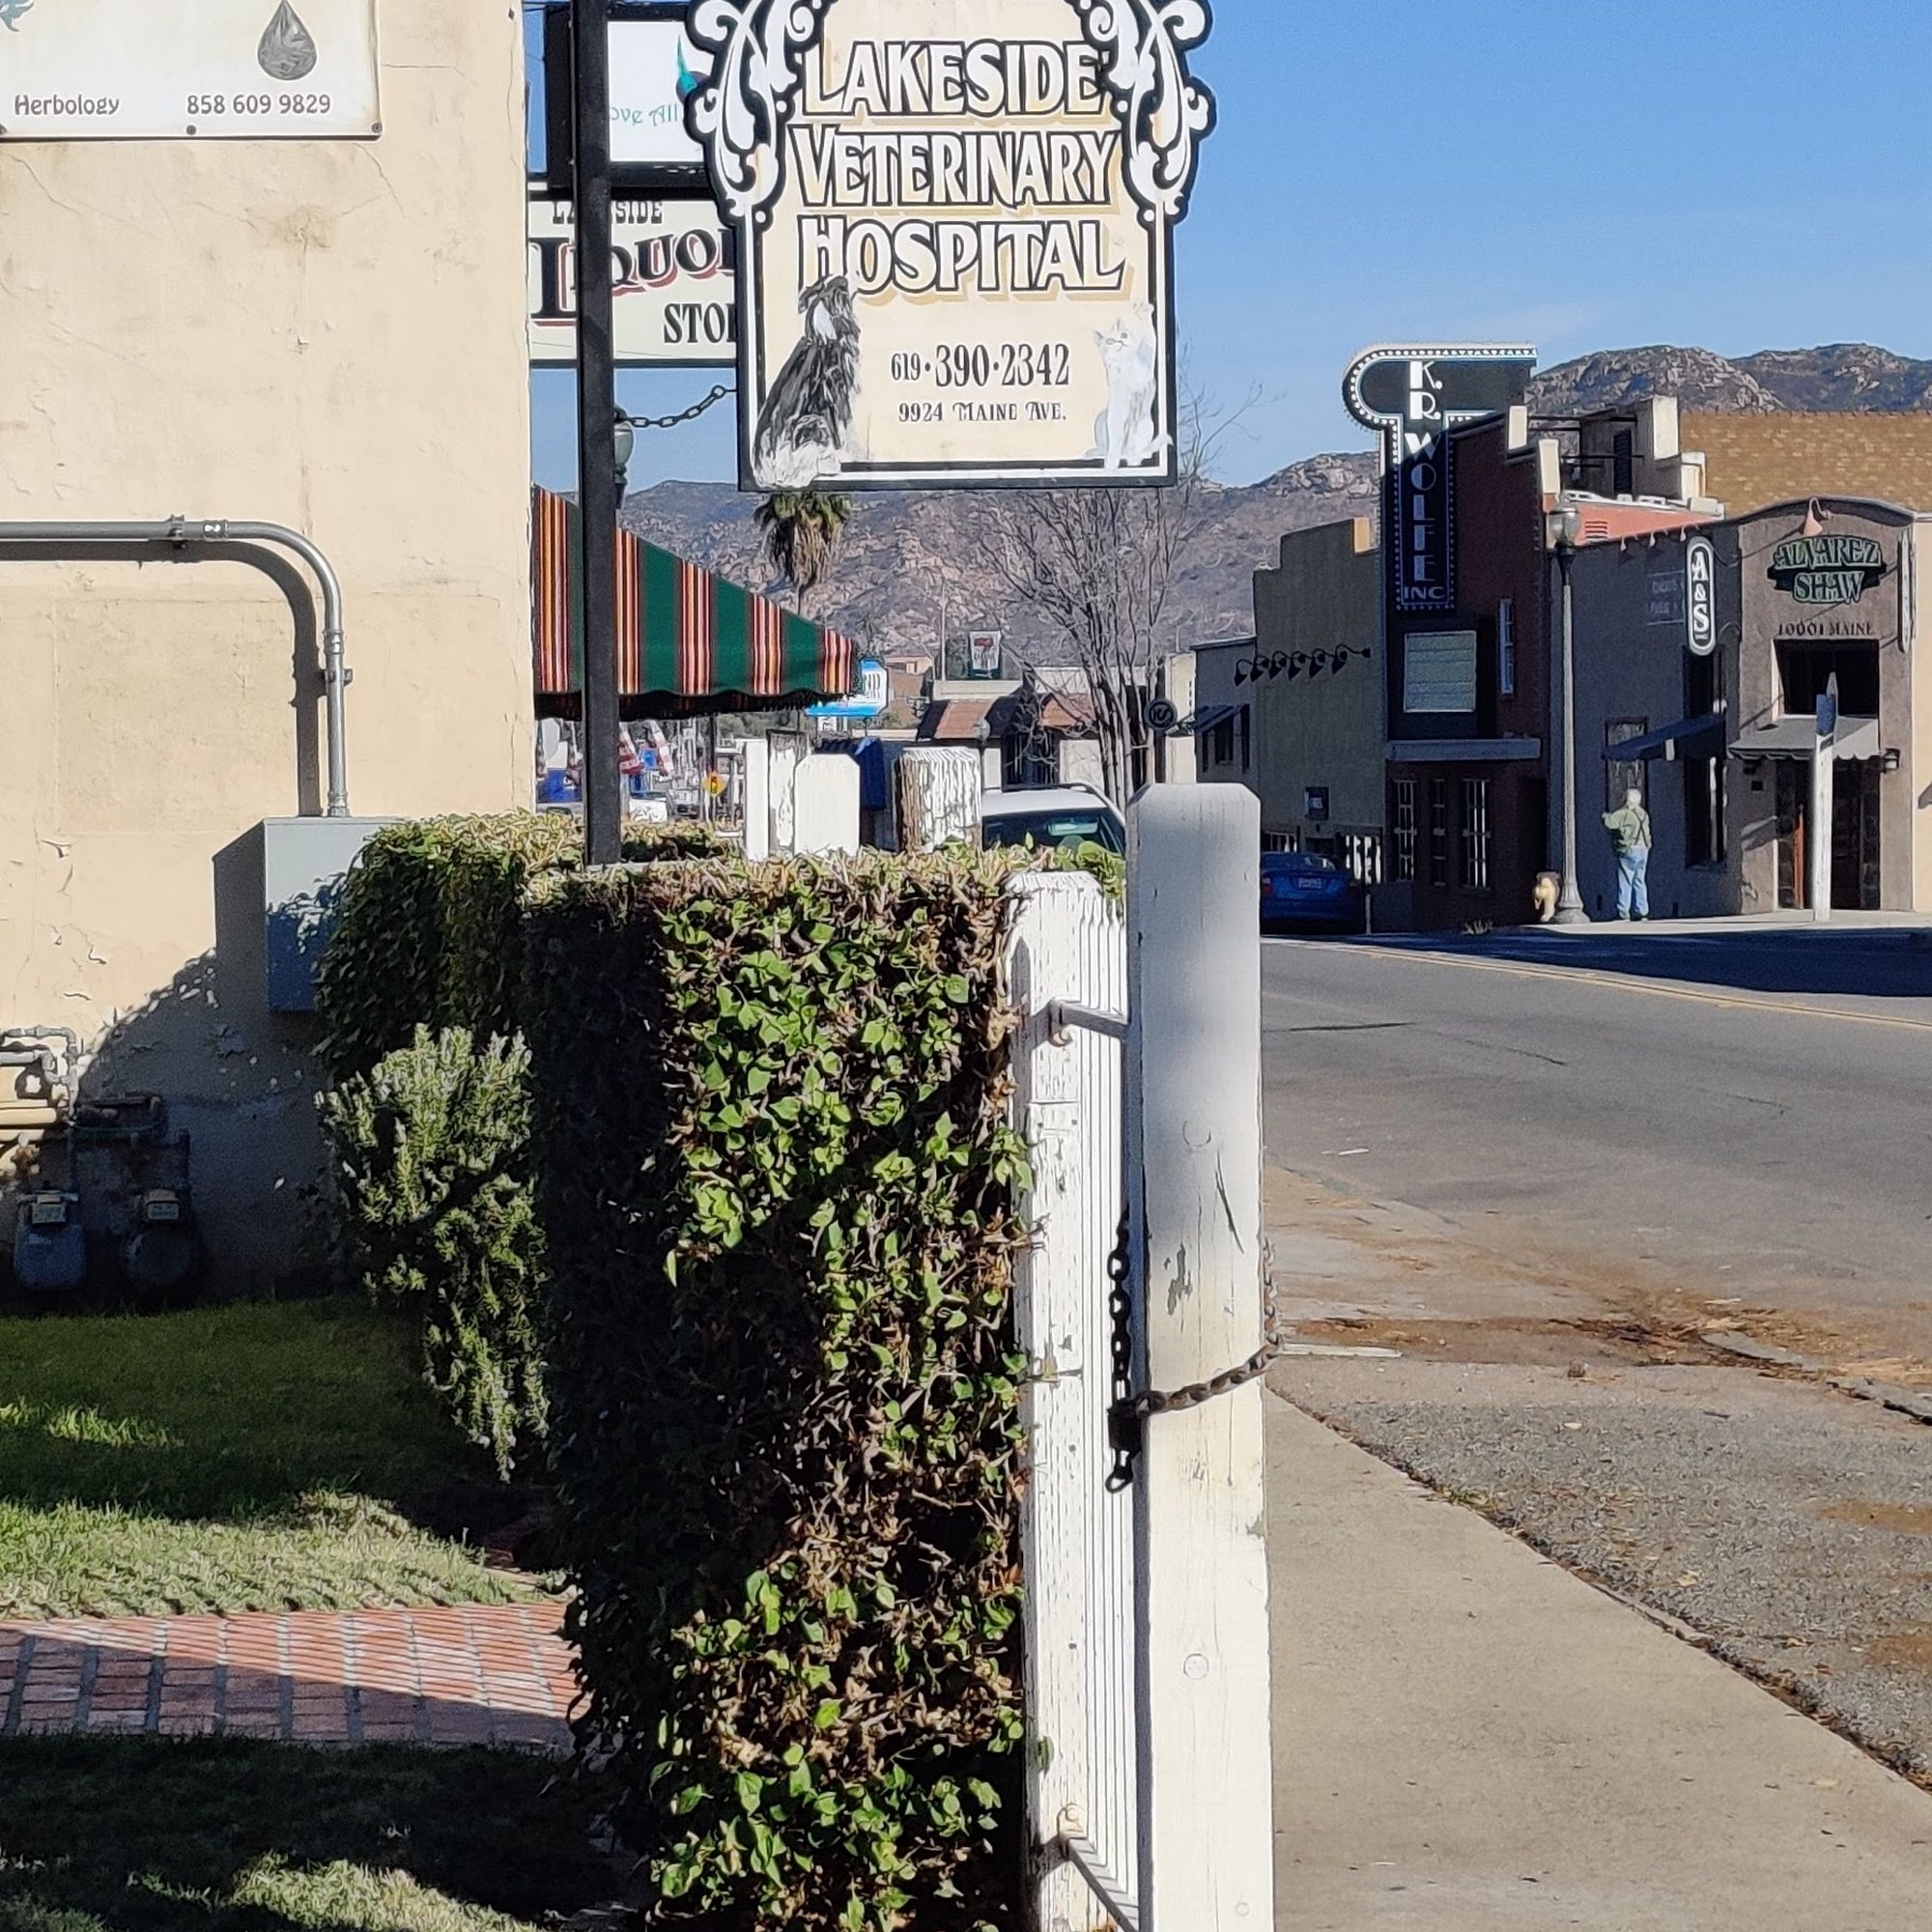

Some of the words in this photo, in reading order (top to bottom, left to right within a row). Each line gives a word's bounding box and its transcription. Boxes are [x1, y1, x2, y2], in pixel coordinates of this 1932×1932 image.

[803, 39, 1104, 117] LAKESIDE
[14, 94, 121, 116] Herbology
[186, 95, 226, 115] 858
[233, 95, 271, 114] 609
[278, 94, 331, 114] 9829
[787, 124, 1122, 210] VETERINARY
[797, 214, 1126, 292] HOSPITAL
[898, 402, 943, 422] 9924
[1774, 536, 1883, 570] ALVAREZ
[1404, 585, 1445, 600] INC
[1794, 571, 1865, 604] SHAW
